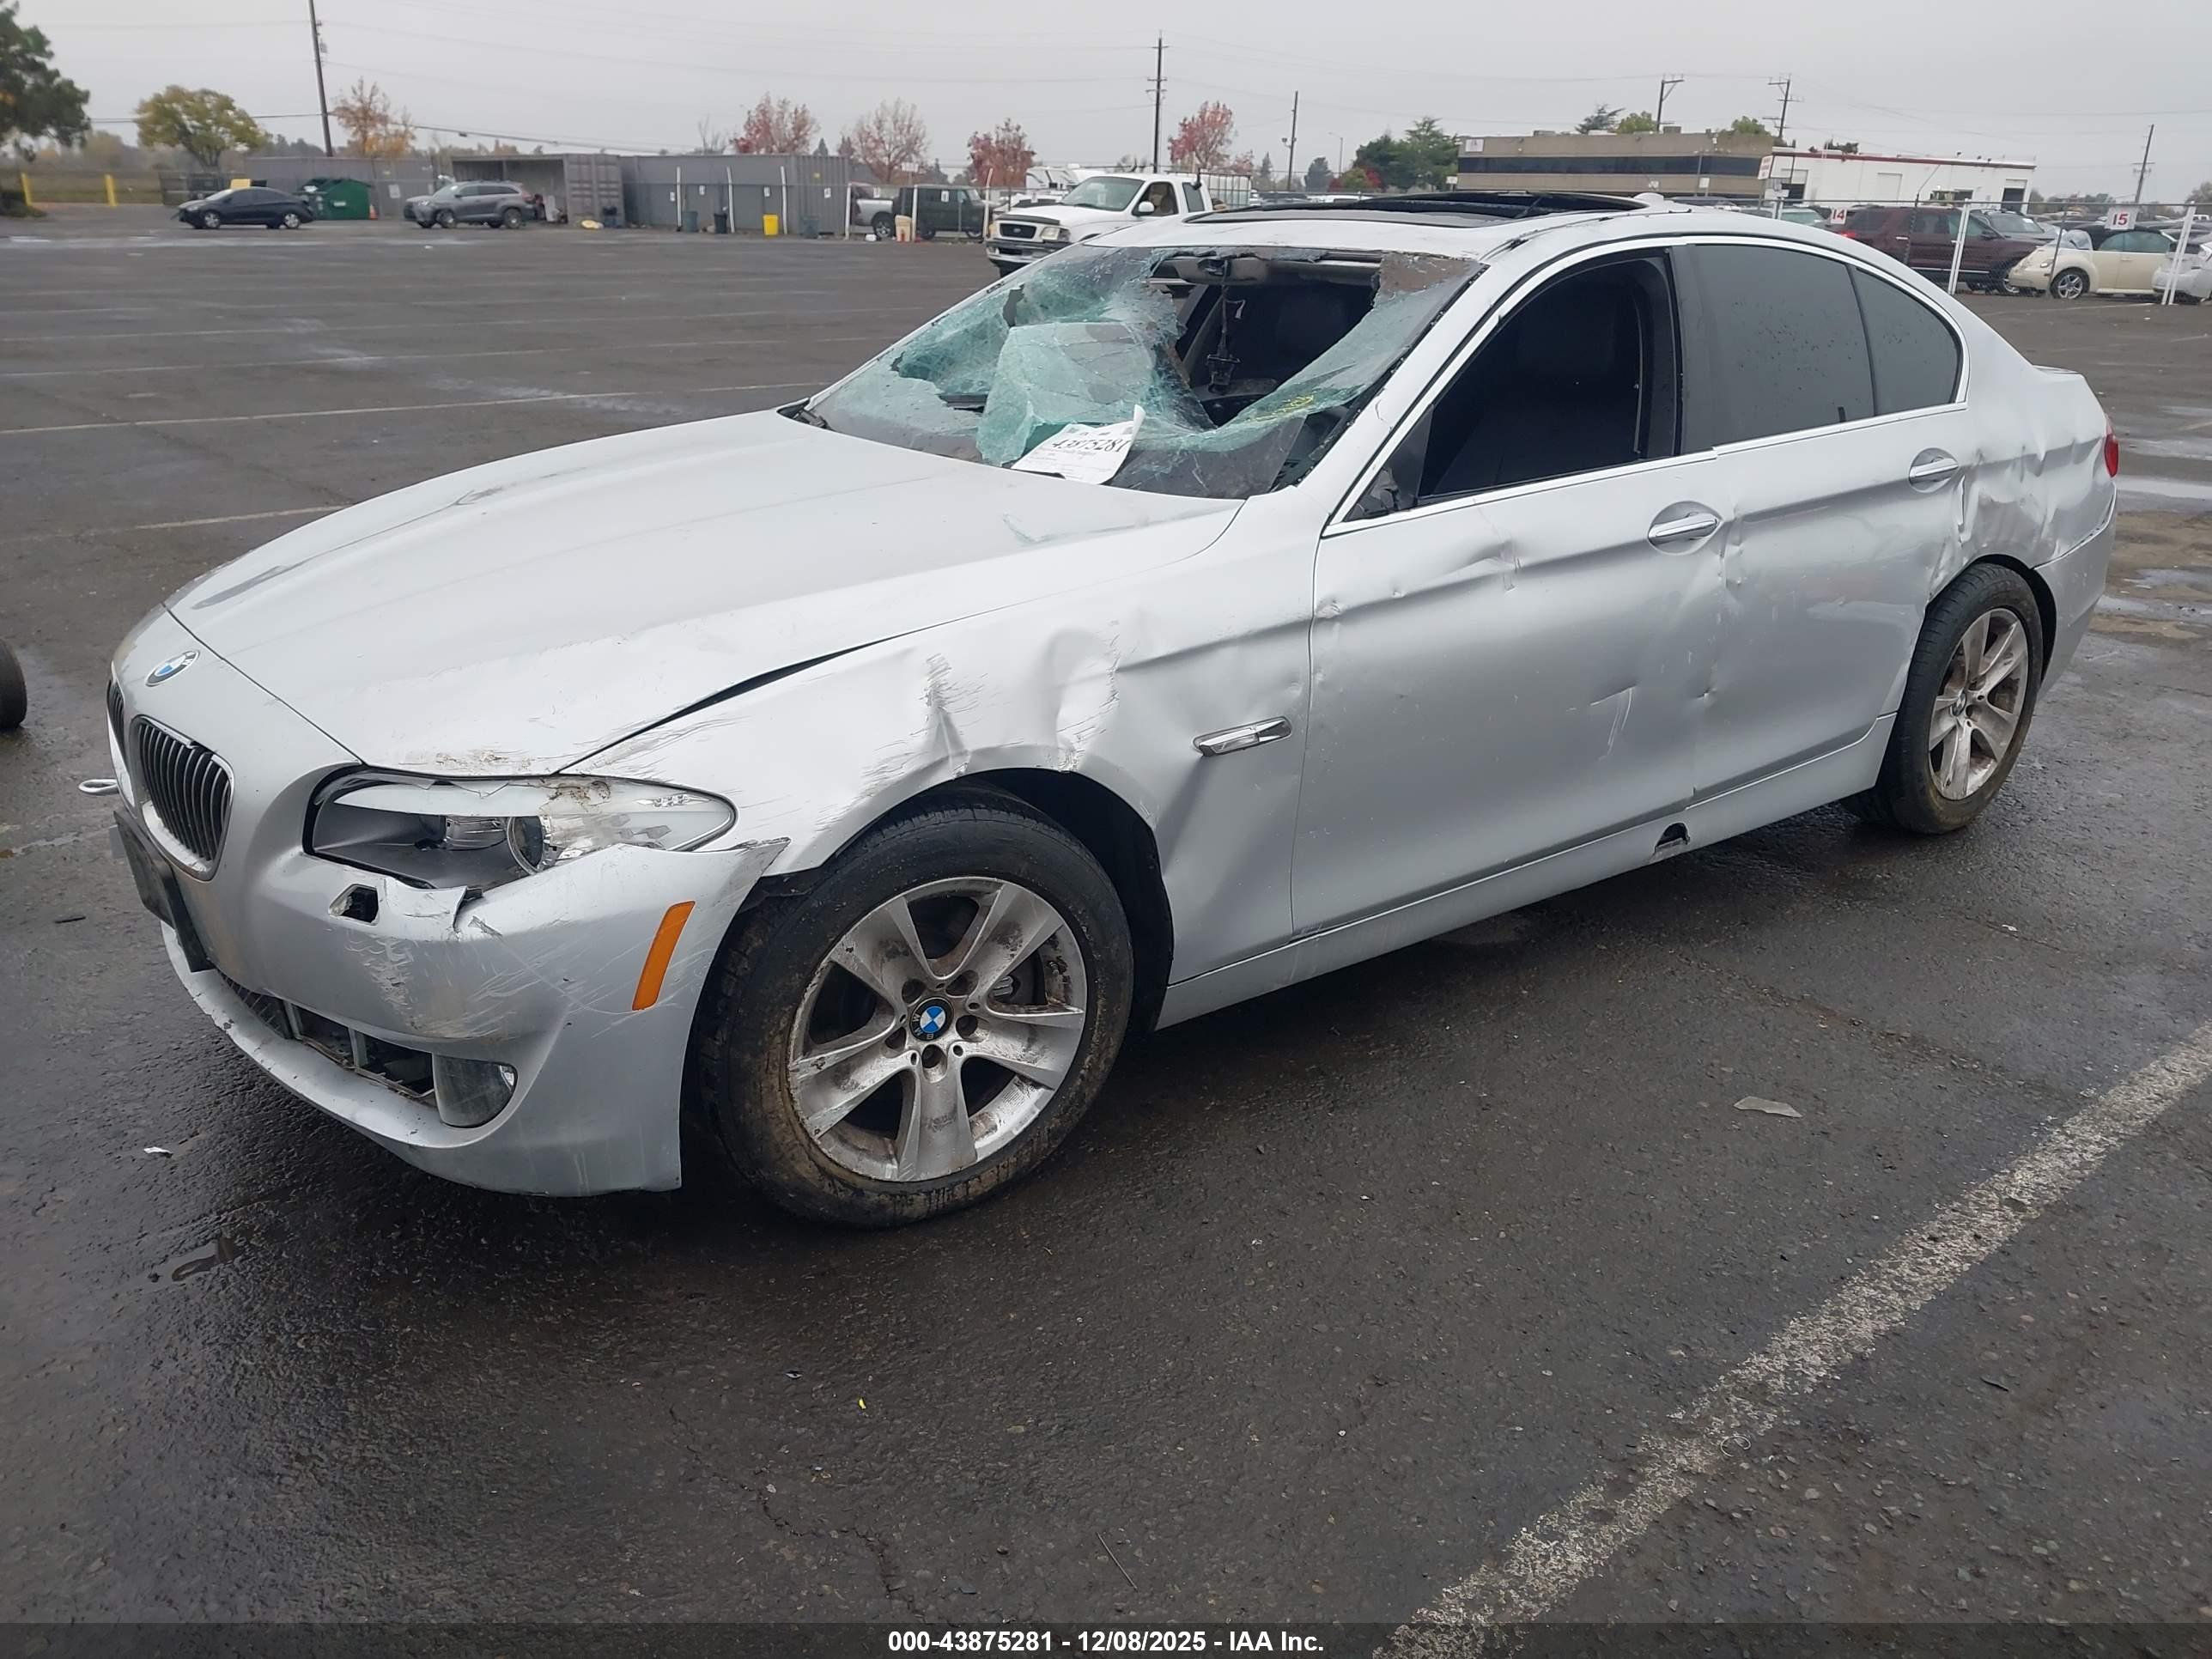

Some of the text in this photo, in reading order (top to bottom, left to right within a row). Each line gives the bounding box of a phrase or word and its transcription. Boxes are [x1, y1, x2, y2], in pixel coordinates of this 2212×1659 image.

[1832, 209, 1845, 220] 14
[2112, 213, 2128, 226] 15
[1052, 439, 1131, 453] 43875281
